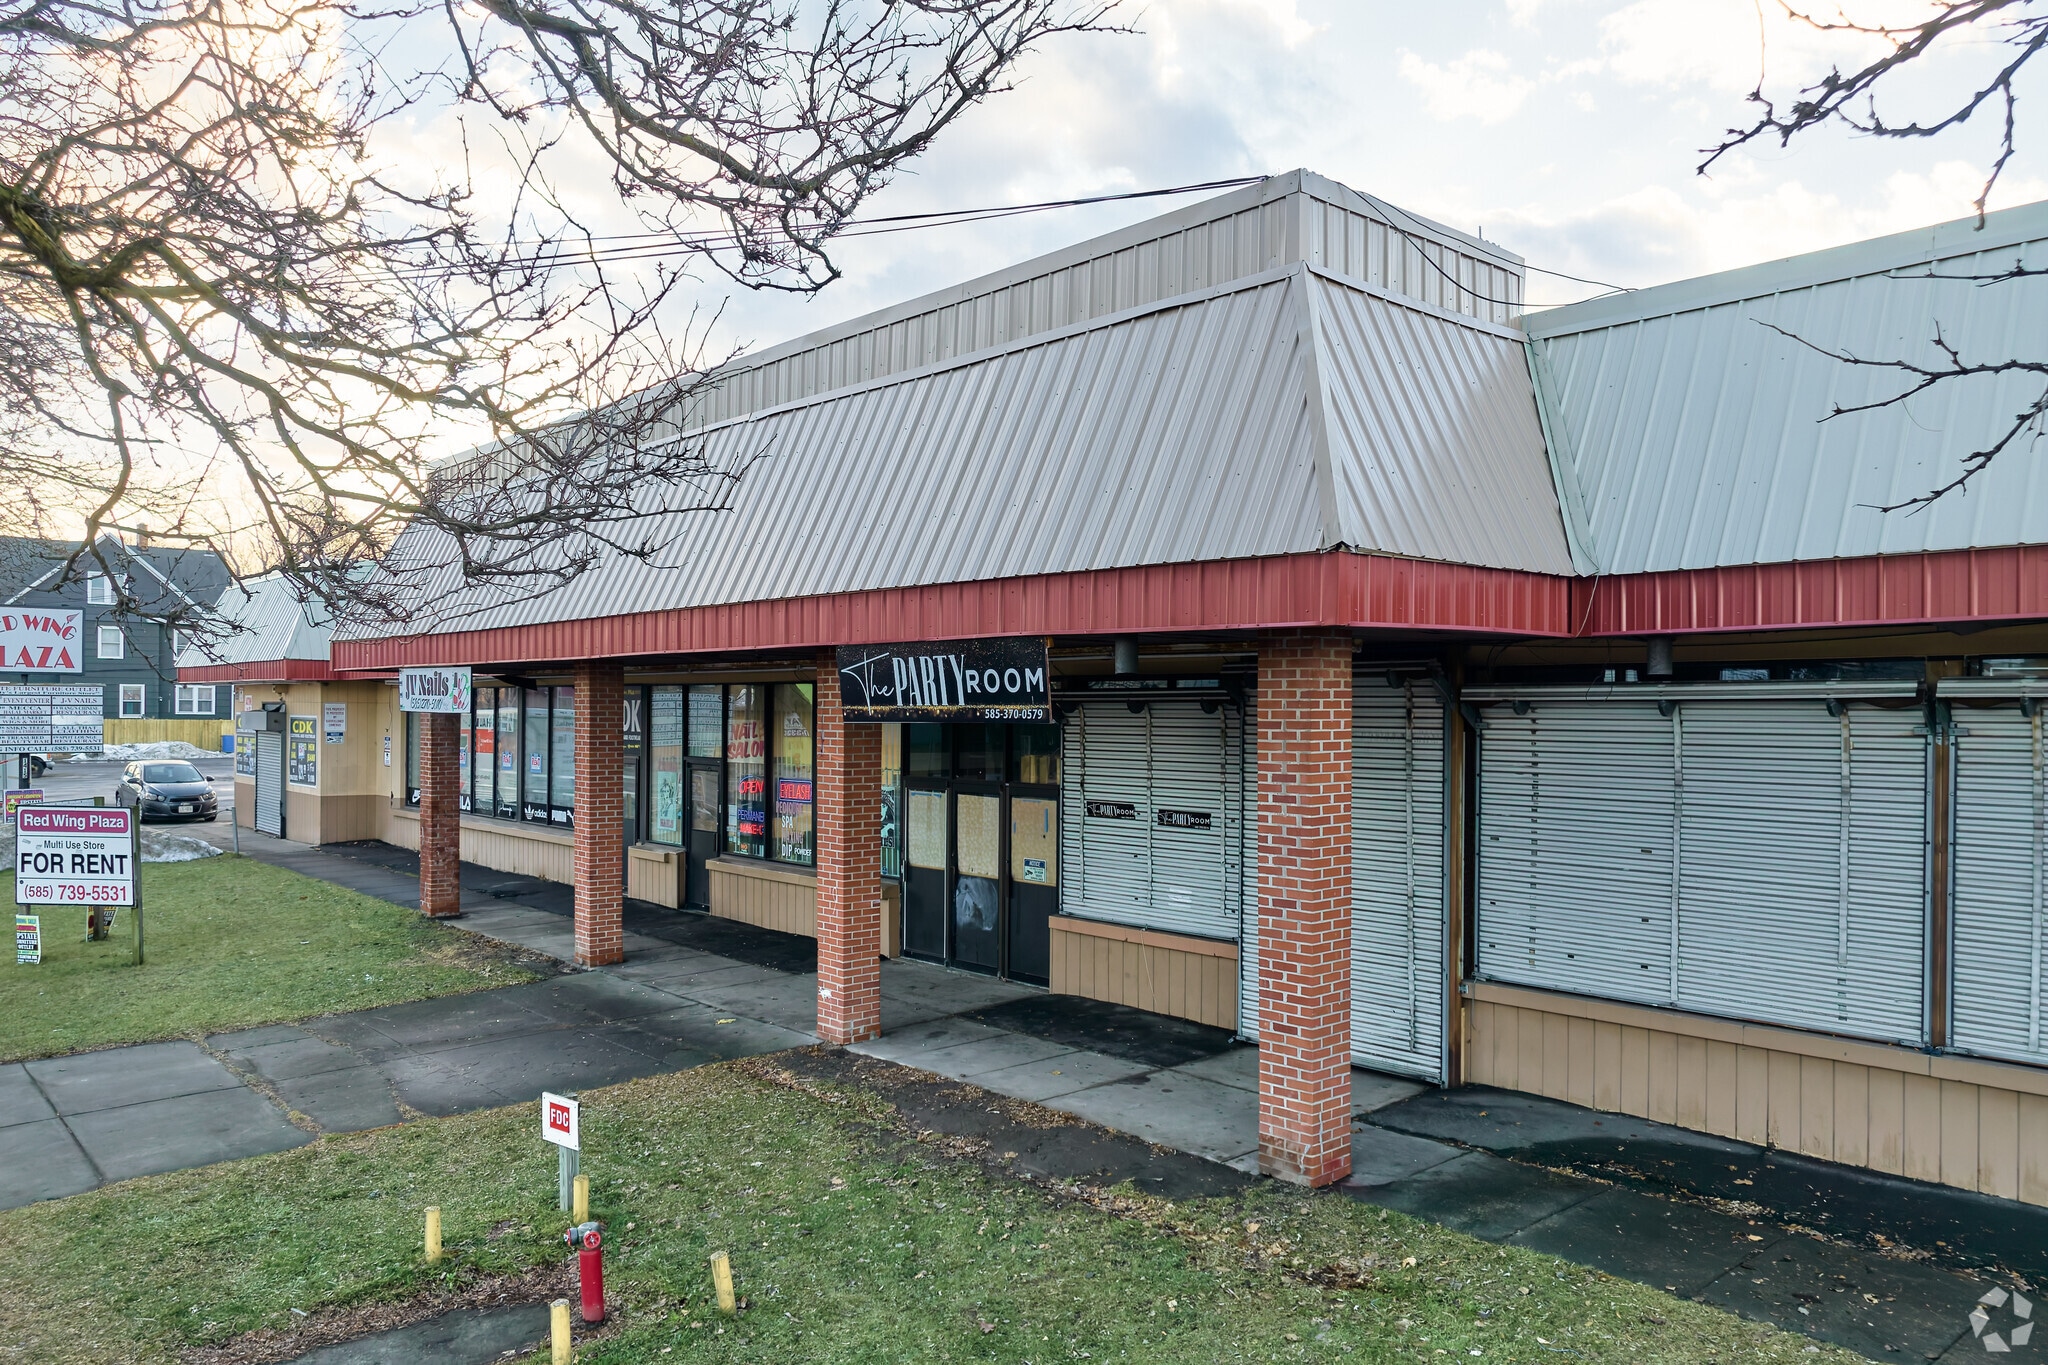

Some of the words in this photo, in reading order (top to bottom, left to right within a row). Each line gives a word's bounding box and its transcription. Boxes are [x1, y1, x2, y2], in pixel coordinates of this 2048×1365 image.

[22, 614, 77, 640] WING
[406, 674, 417, 700] JV
[419, 671, 449, 696] Nails
[841, 652, 895, 716] The
[892, 654, 965, 706] PARTY
[966, 668, 1044, 694] ROOM
[984, 708, 1043, 720] 585-370-0579
[292, 720, 314, 734] CDK
[739, 780, 764, 794] OPEN
[780, 783, 811, 800] EYELASH
[1100, 804, 1118, 816] PARTY
[24, 814, 49, 826] Red
[52, 815, 85, 830] Wing
[90, 815, 124, 828] Plaza
[782, 816, 793, 828] SPA
[44, 840, 63, 849] Multi
[66, 840, 80, 849] Use
[83, 841, 105, 849] Store
[782, 844, 792, 856] DIP
[21, 852, 64, 873] FOR
[72, 854, 128, 874] RENT
[24, 884, 53, 899] (585)
[58, 885, 126, 901] 739-5531
[551, 1108, 569, 1127] FDC
